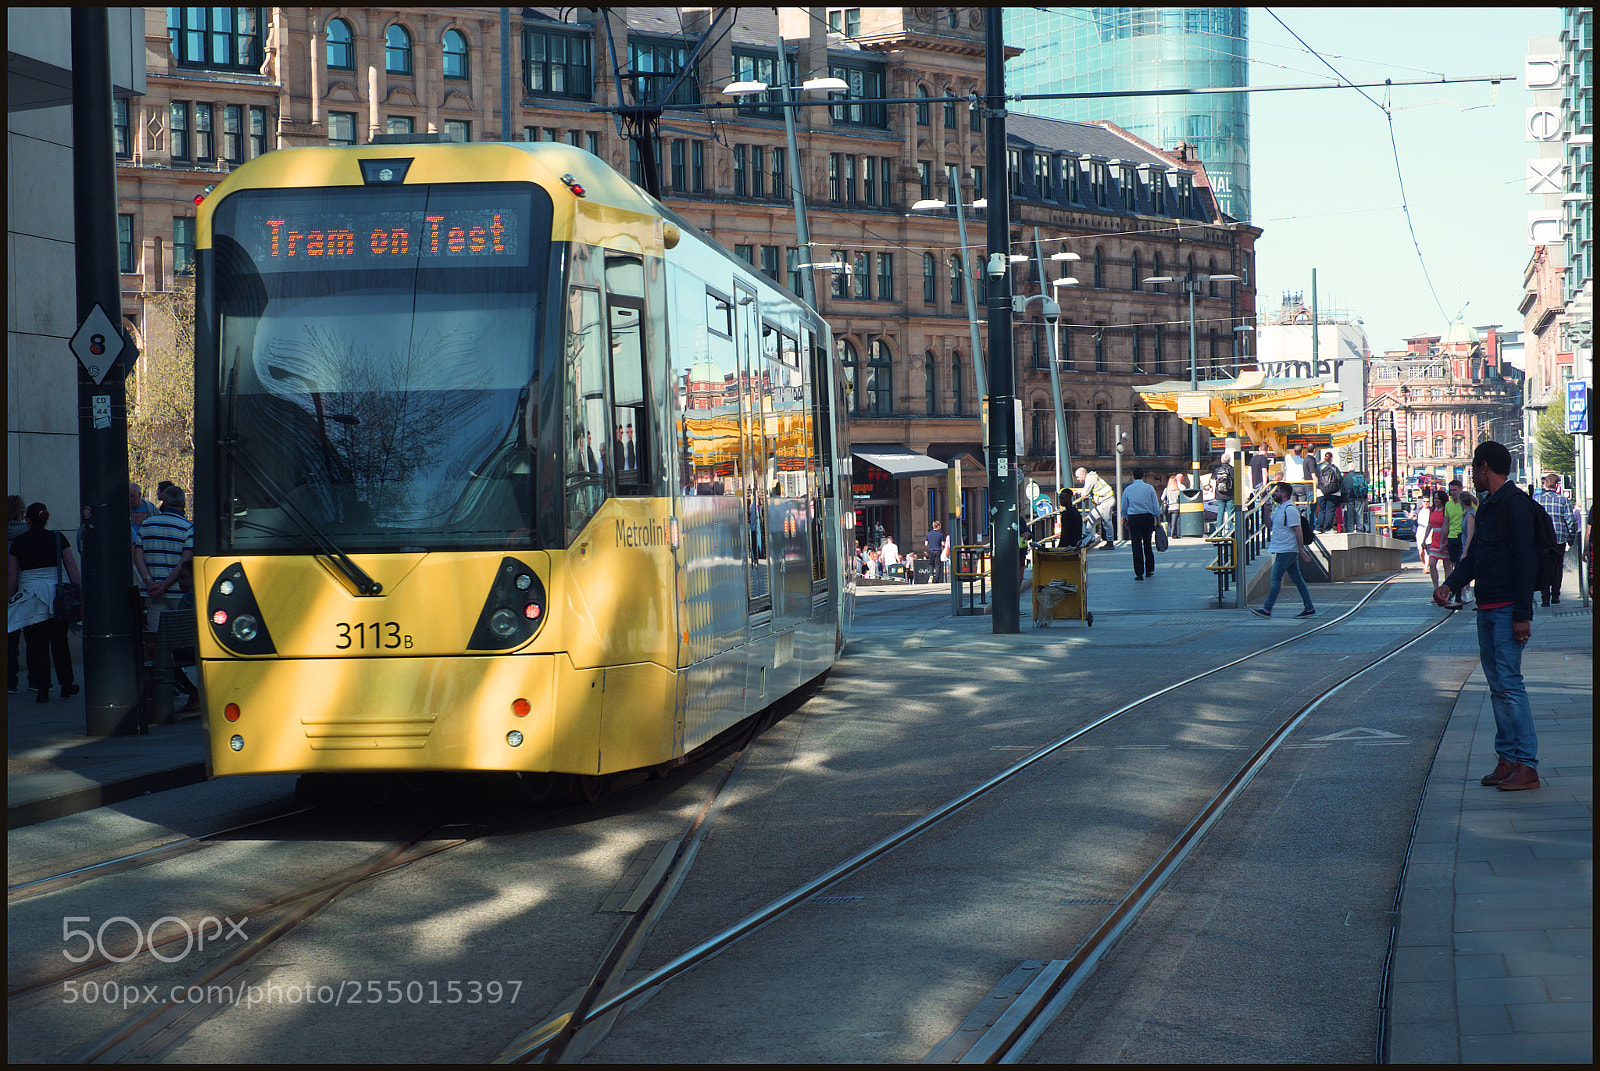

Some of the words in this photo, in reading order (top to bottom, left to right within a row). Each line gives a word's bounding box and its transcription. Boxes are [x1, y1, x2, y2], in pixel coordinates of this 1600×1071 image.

[1207, 176, 1232, 193] NAL
[266, 219, 354, 257] Tram
[371, 228, 409, 254] on
[426, 213, 505, 253] Test
[90, 333, 106, 355] 8
[1261, 360, 1344, 384] wmer
